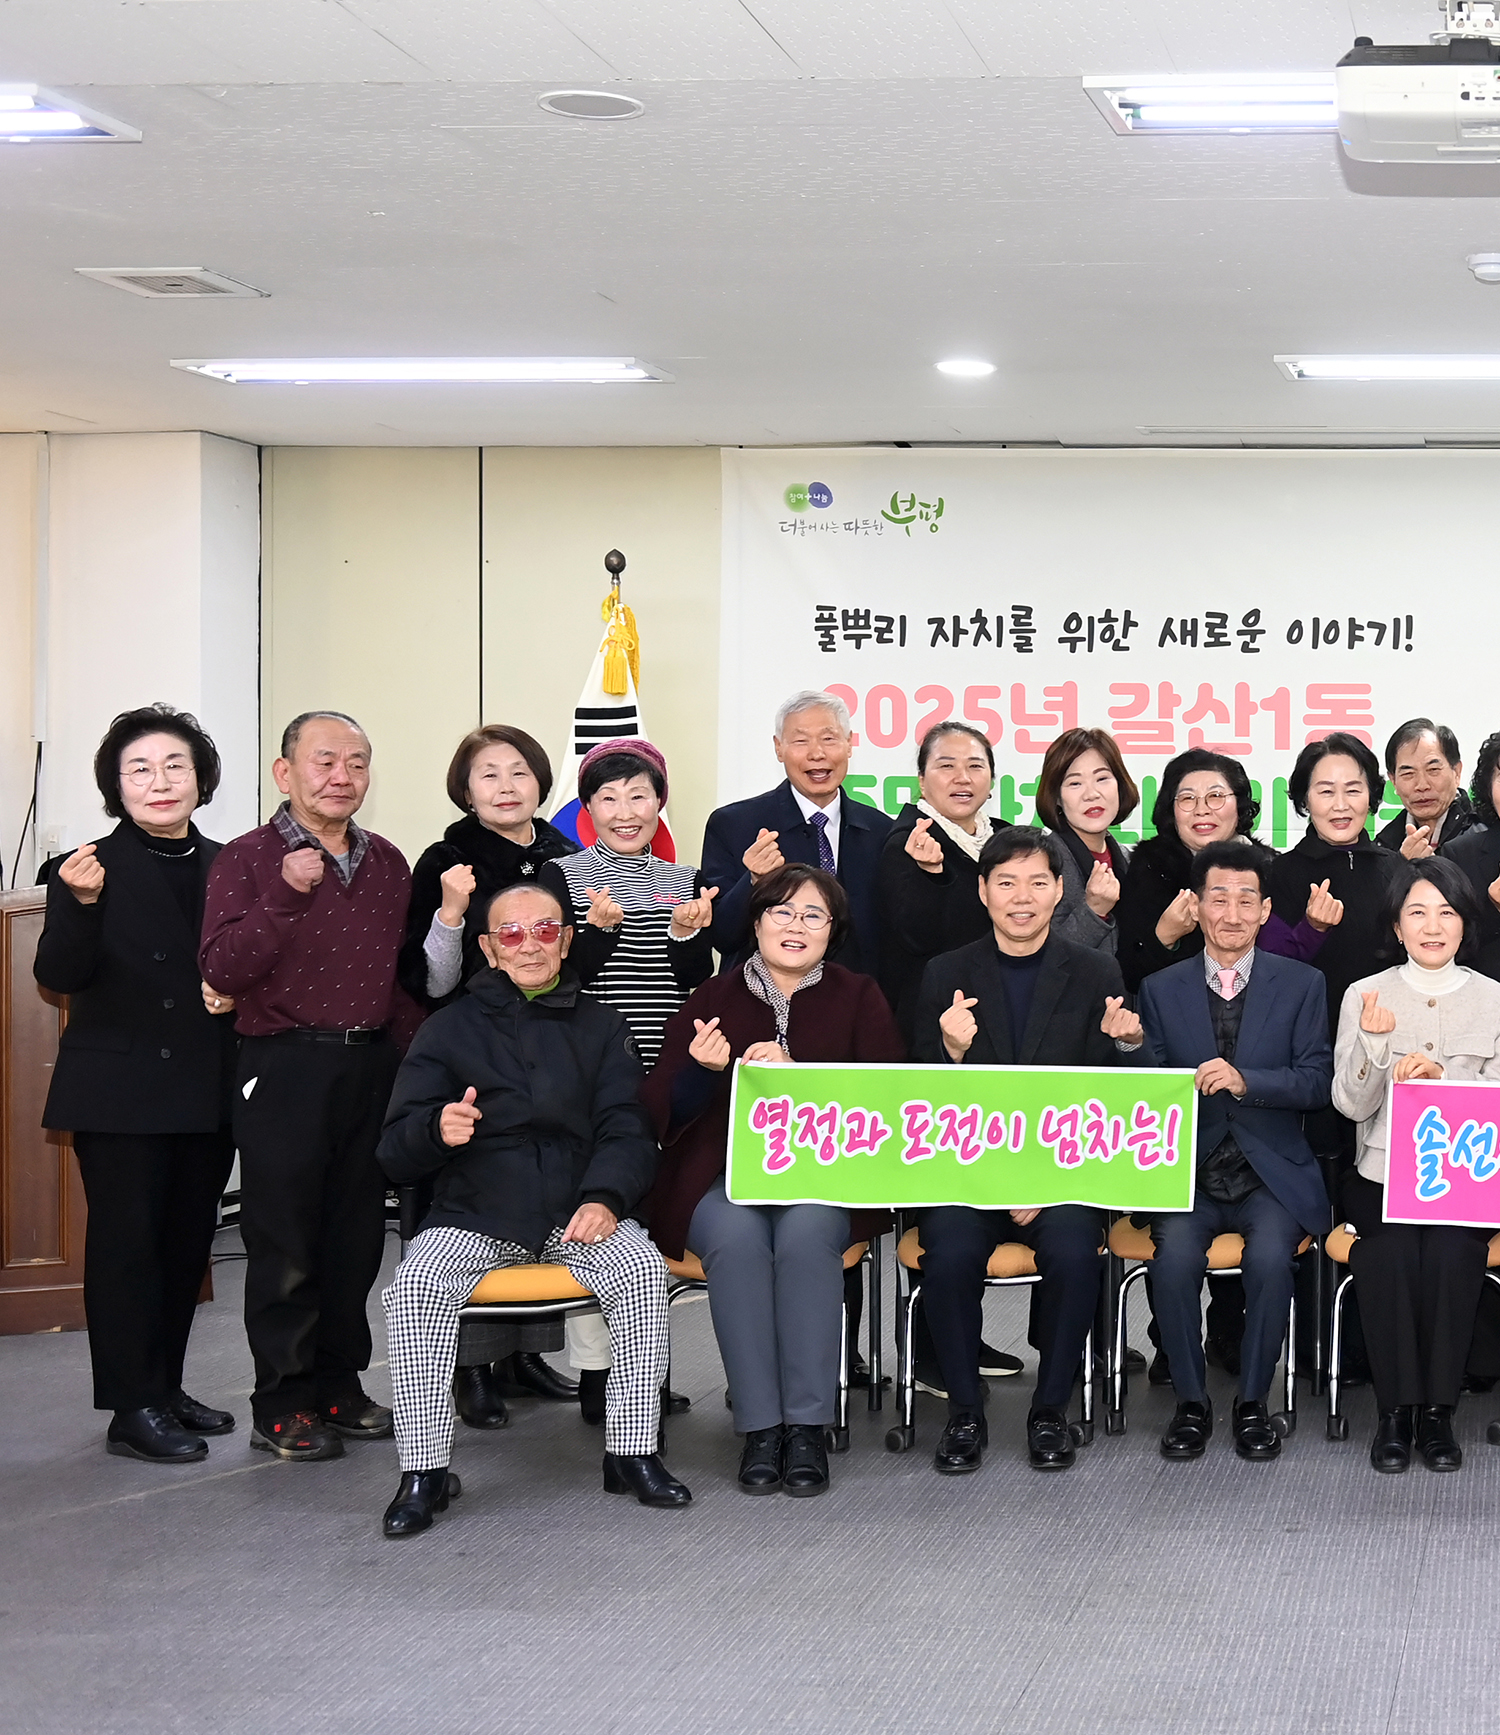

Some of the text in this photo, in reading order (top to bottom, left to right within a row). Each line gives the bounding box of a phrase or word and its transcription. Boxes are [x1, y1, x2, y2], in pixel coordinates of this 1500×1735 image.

[778, 491, 944, 537] 더불어 사는 따뜻한 부평
[814, 604, 1413, 653] 풀뿌리 자치를 위한 새로운 이야기!
[1108, 681, 1375, 756] 갈산1동
[753, 1099, 1179, 1171] 열정과 도전이 넘치는!
